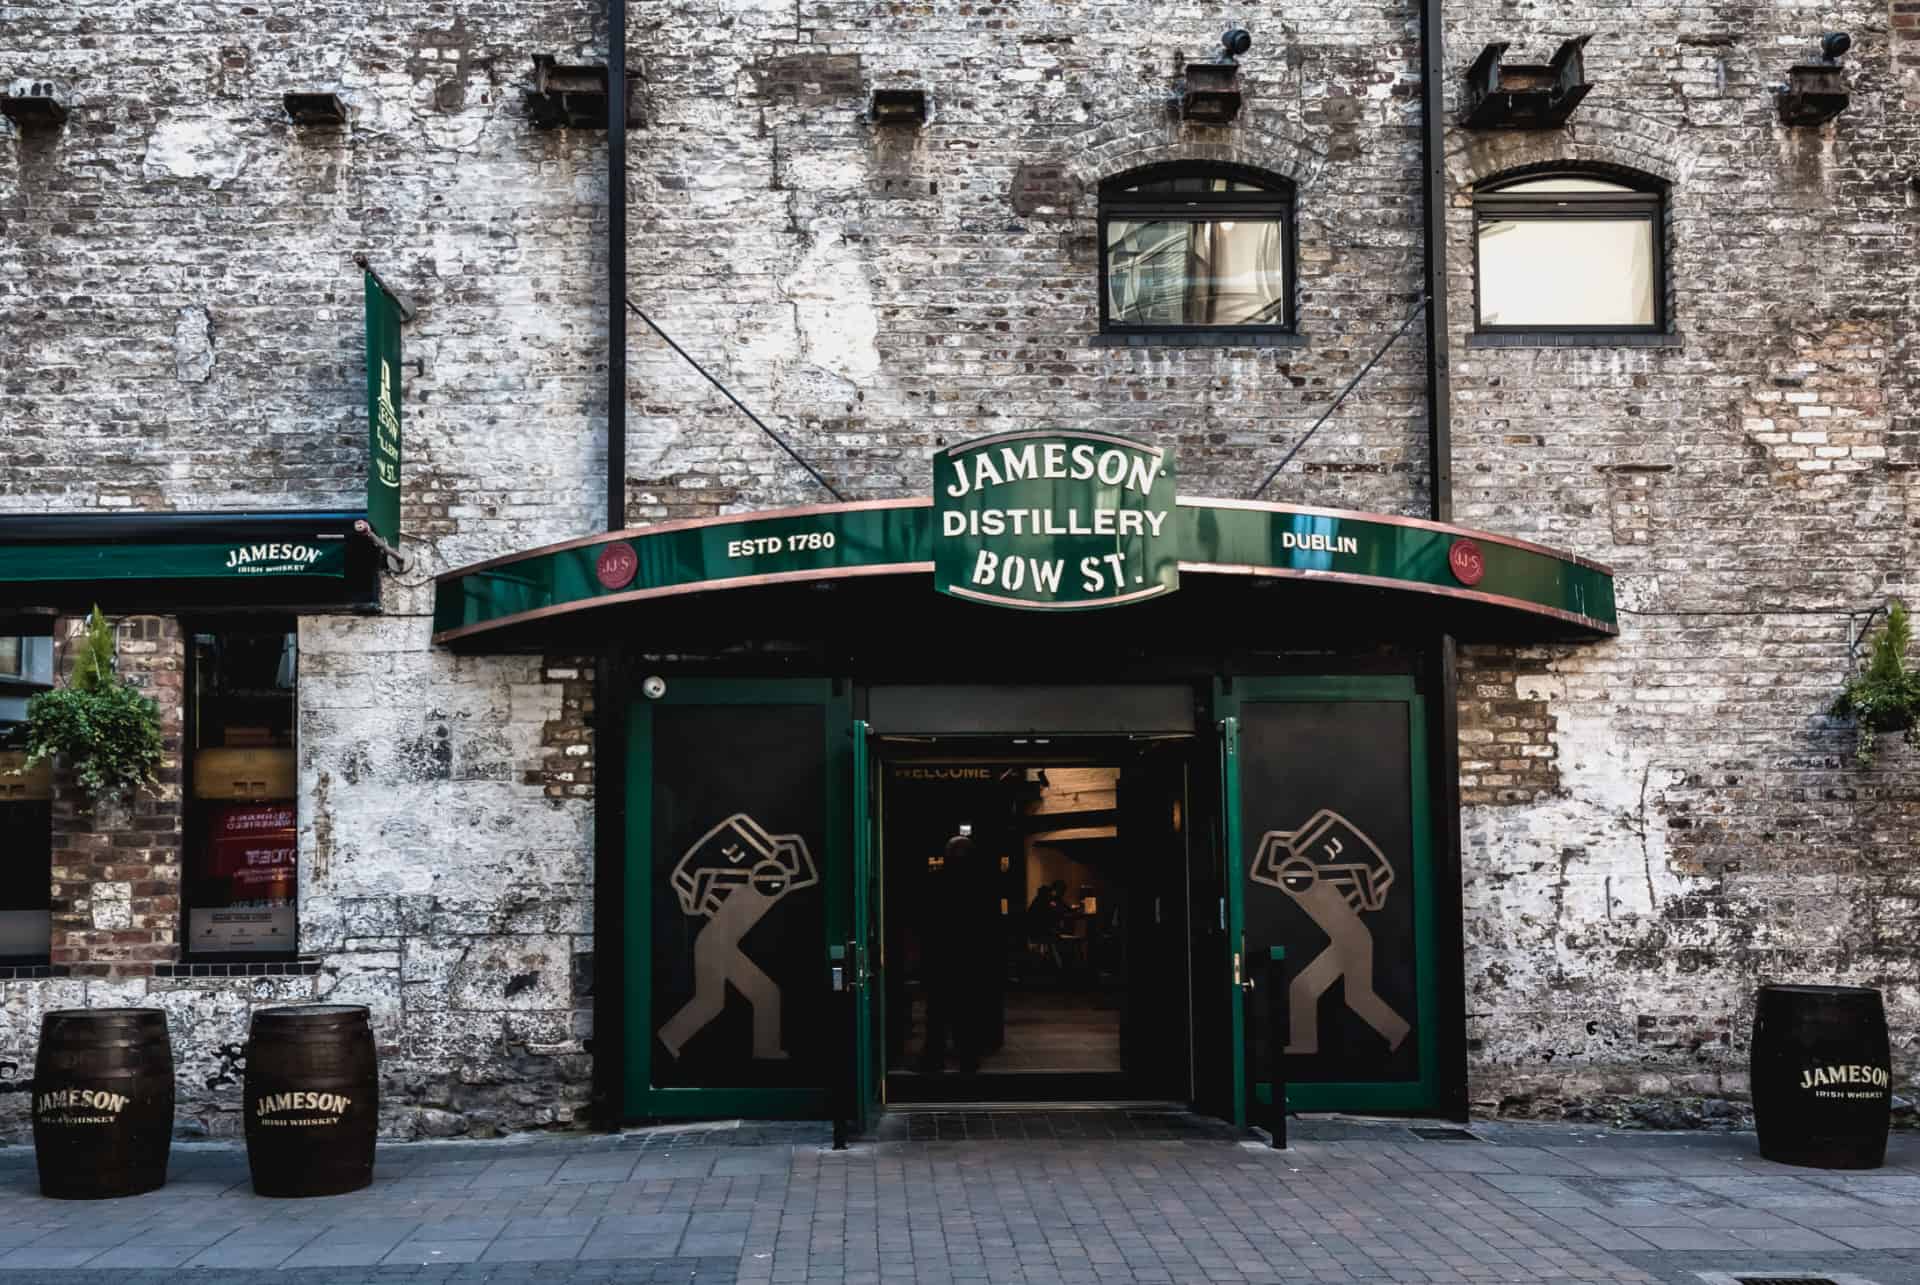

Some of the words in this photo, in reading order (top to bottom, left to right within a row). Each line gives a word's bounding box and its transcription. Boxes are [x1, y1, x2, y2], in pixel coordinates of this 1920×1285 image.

[947, 443, 1167, 497] JAMESON
[943, 508, 1168, 537] DISTILLERY
[727, 537, 782, 558] ESTD
[787, 532, 836, 551] 1780
[1282, 532, 1358, 554] DUBLIN
[226, 544, 322, 568] JAMESON
[972, 550, 1065, 593] BOW
[1080, 553, 1144, 593] ST.
[38, 1089, 130, 1113] JAMESON
[257, 1091, 351, 1117] JAMESON
[1815, 1090, 1844, 1098] IRISH
[290, 1117, 339, 1126] WHISKEY
